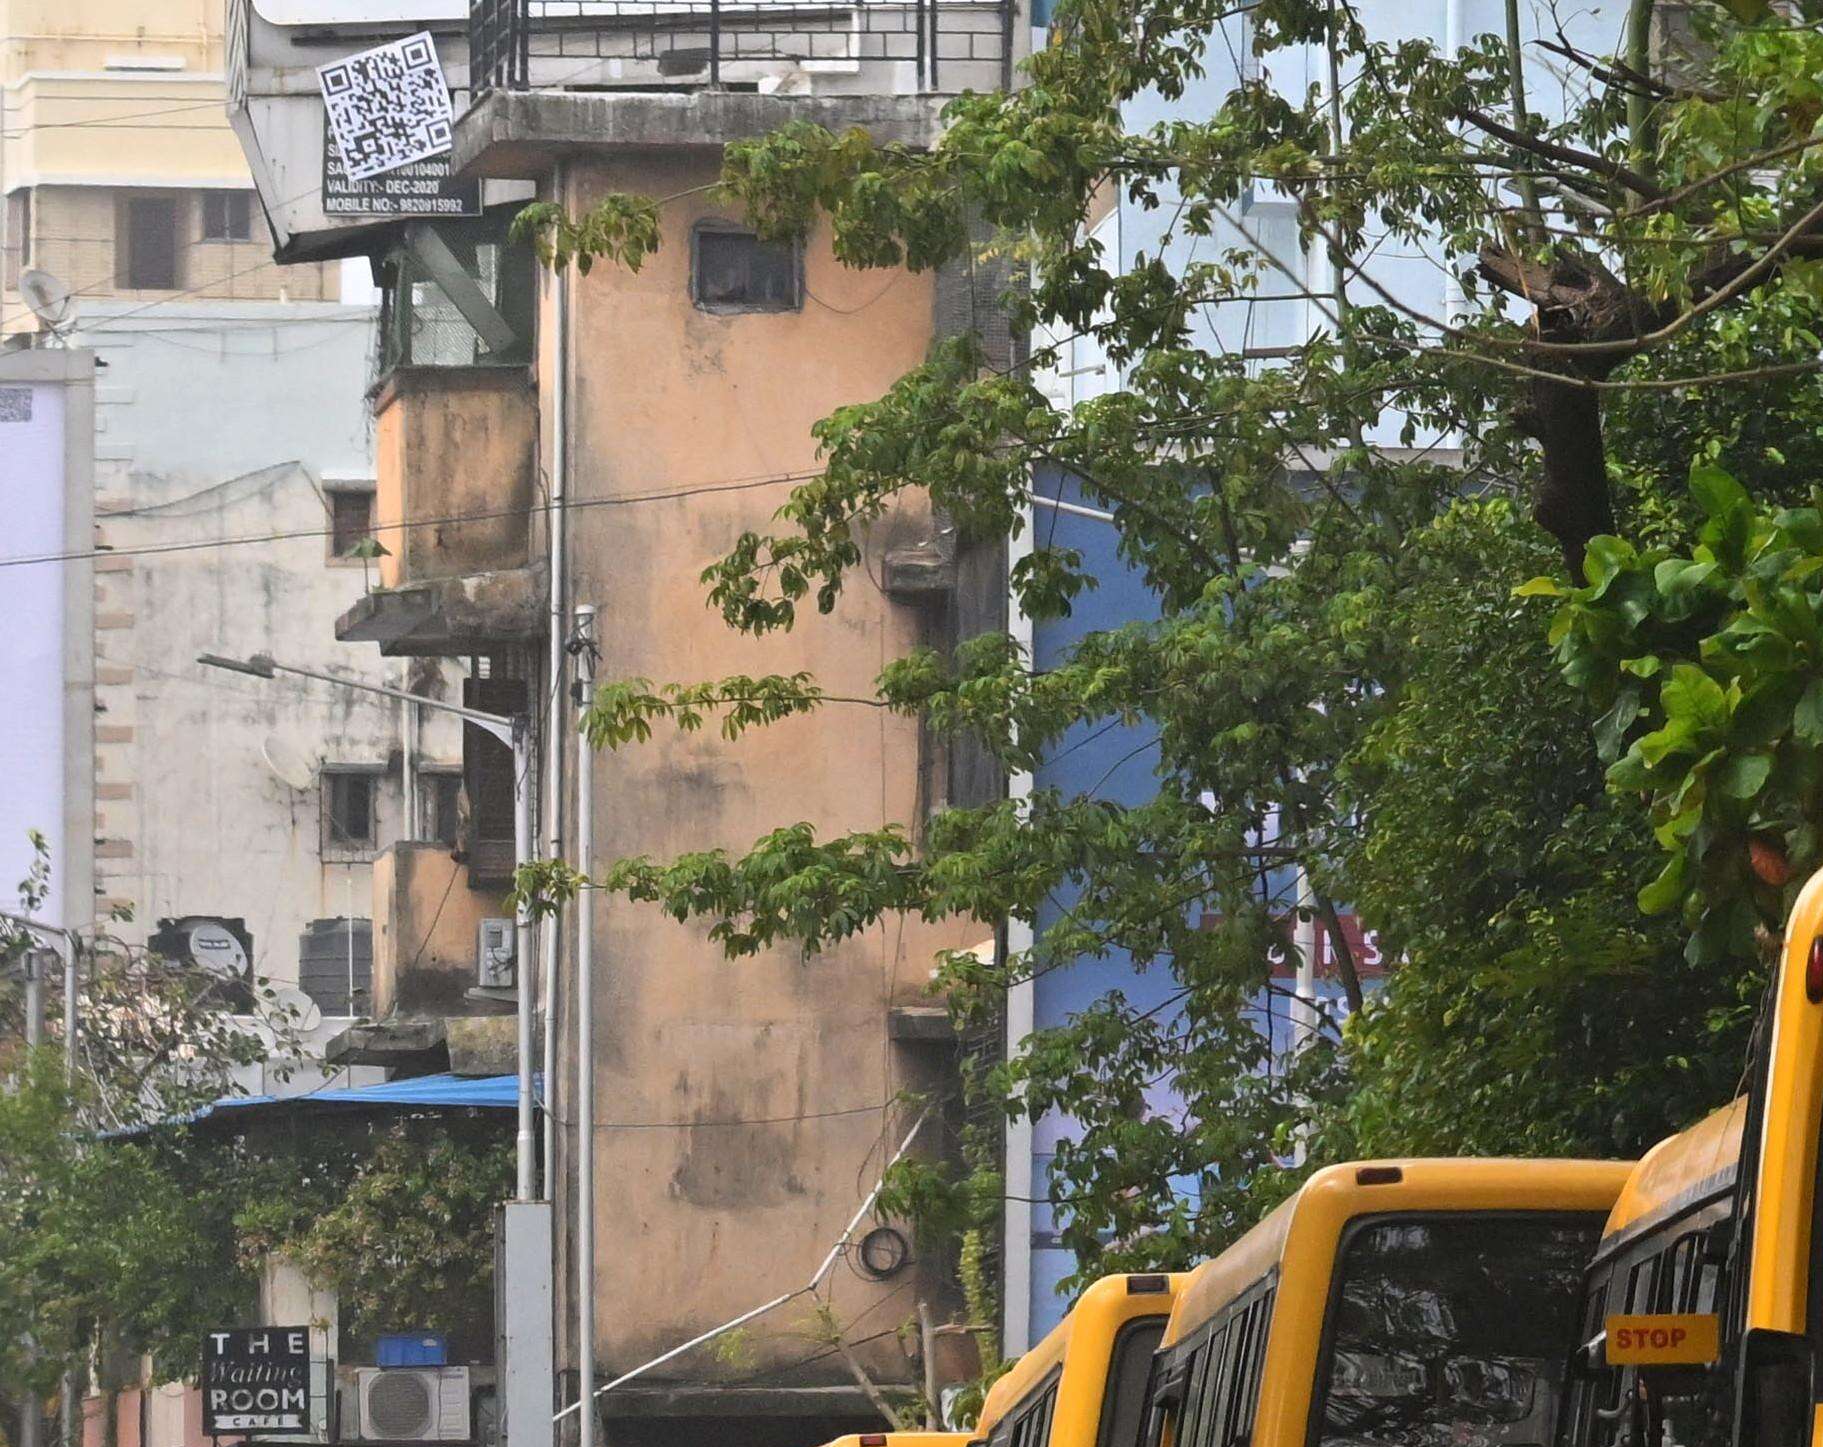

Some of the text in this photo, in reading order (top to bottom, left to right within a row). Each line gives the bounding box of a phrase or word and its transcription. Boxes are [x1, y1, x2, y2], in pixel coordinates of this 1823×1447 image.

[385, 180, 440, 194] DEC-2020
[326, 197, 370, 211] MOBILE
[209, 1332, 304, 1355] THE
[1616, 1328, 1687, 1349] STOP
[210, 1388, 305, 1411] ROOM
